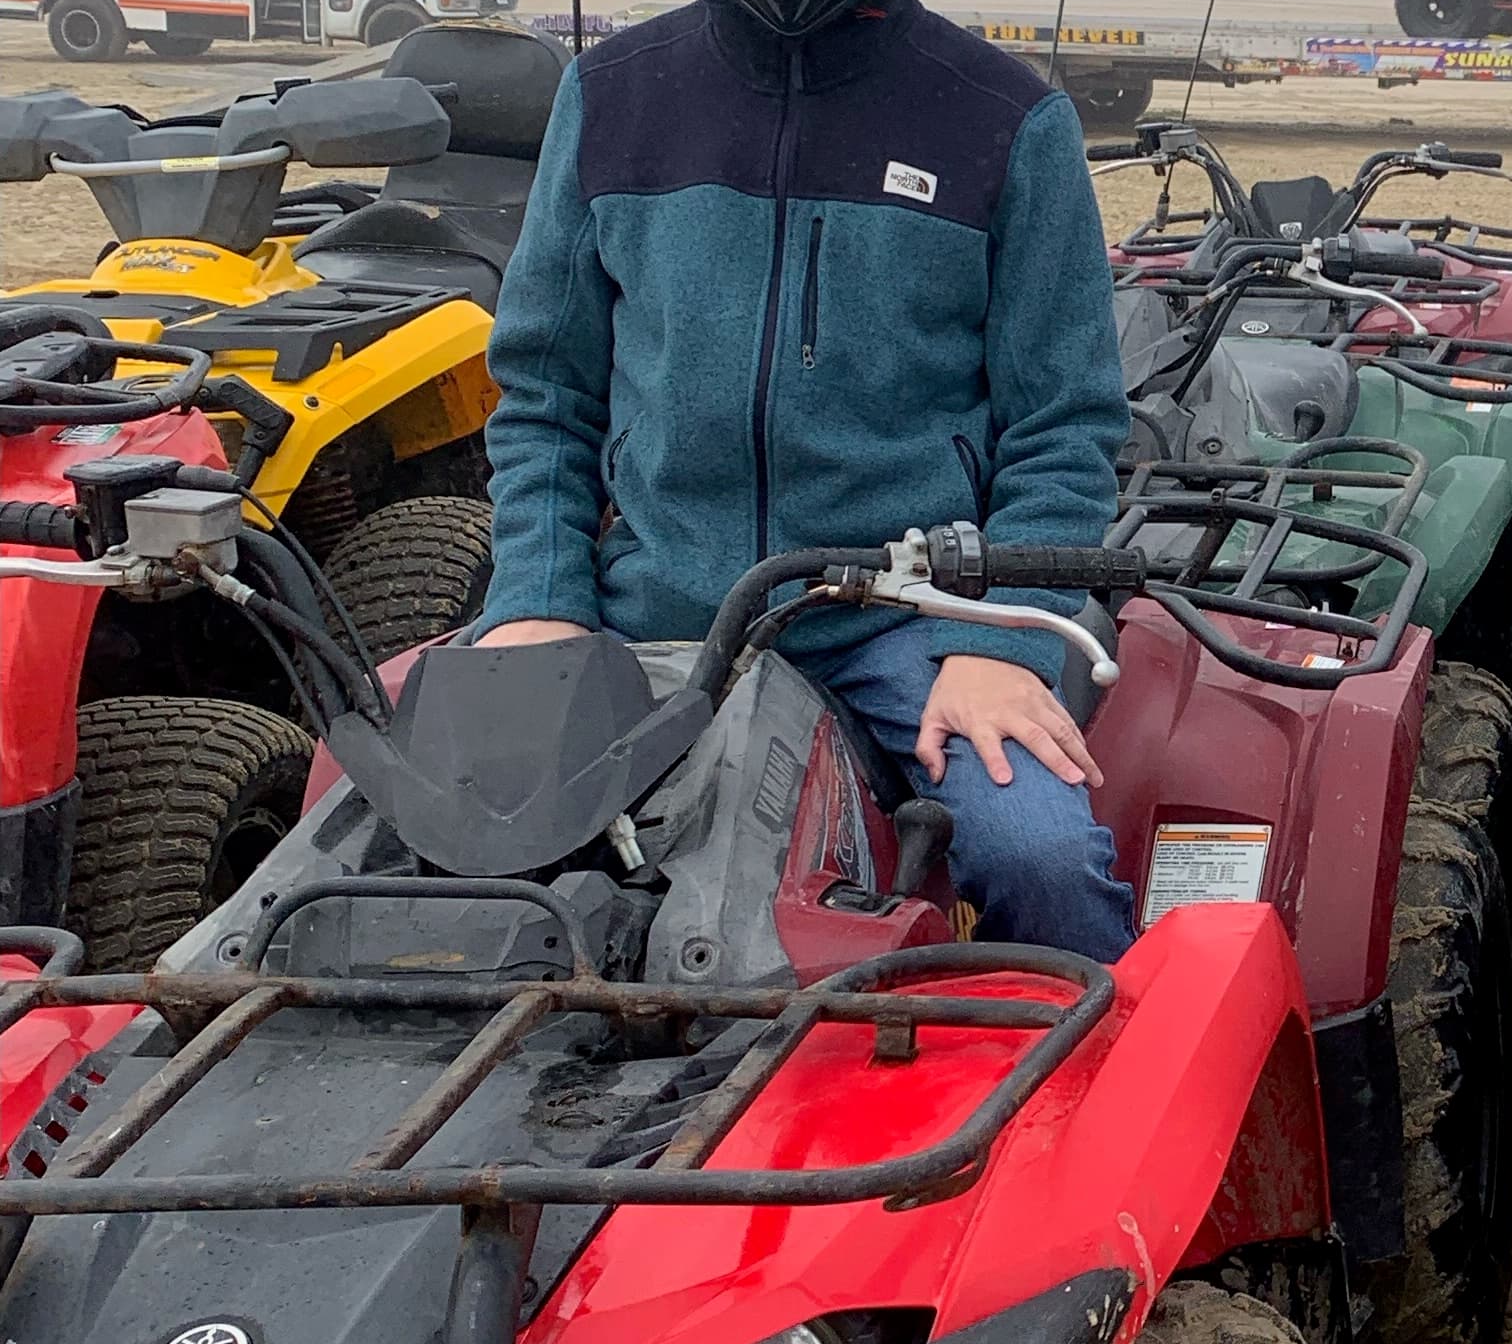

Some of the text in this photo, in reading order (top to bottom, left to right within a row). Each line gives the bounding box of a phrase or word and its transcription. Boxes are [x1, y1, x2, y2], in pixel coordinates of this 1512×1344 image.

[984, 23, 1139, 45] FUN NEVER
[756, 742, 797, 824] YAMAHA
